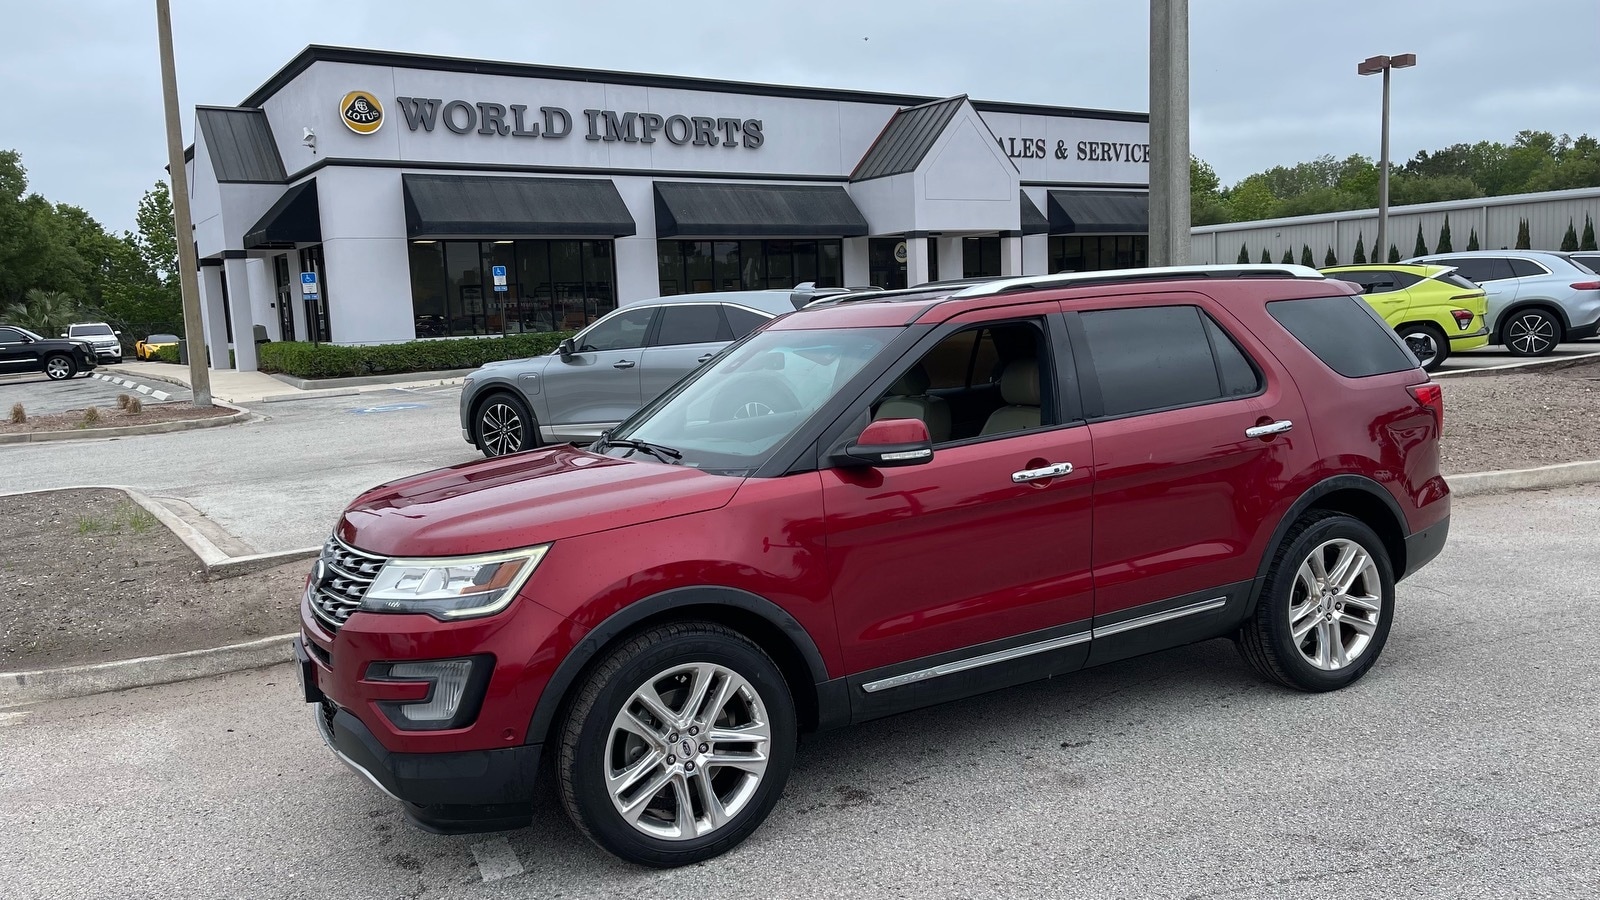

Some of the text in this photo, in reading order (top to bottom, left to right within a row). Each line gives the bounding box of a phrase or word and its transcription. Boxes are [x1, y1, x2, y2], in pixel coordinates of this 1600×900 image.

[347, 110, 379, 121] LOTUS
[397, 97, 765, 149] WORLD IMPORTS
[998, 136, 1149, 163] ALES & SERVICE
